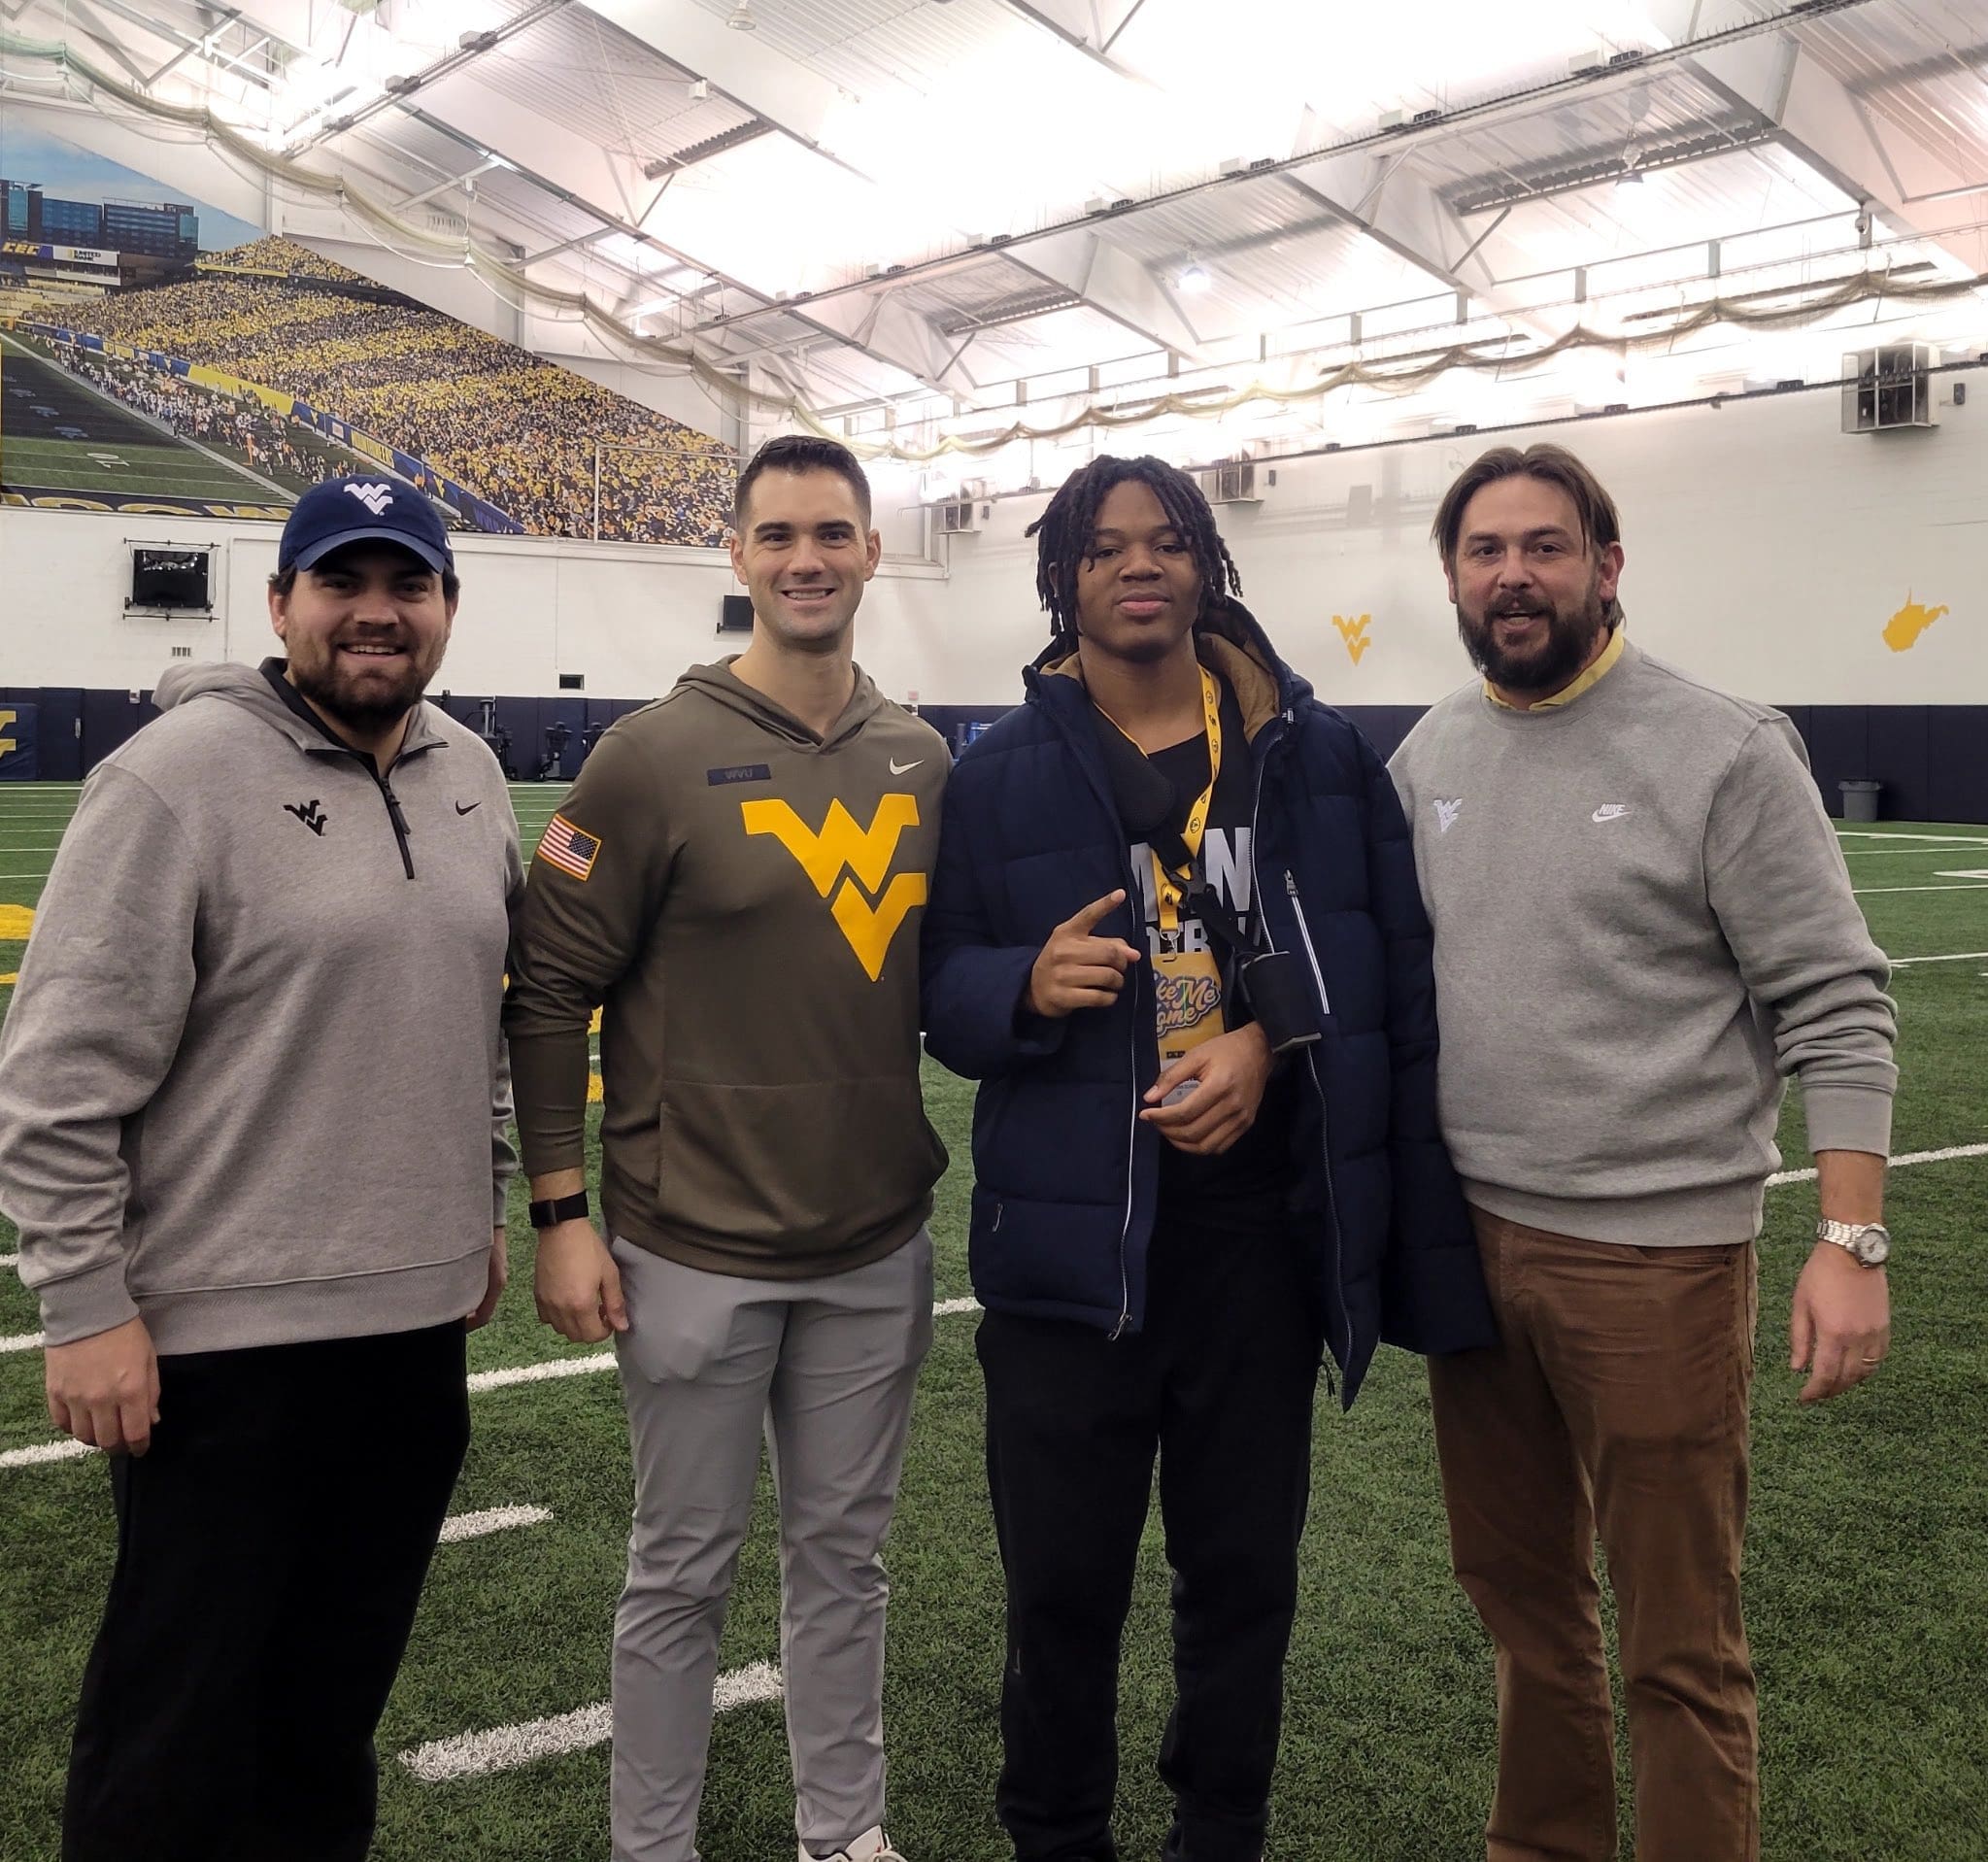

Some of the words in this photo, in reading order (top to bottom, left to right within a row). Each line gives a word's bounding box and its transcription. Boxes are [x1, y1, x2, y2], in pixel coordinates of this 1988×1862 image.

[1599, 803, 1626, 815] NIKE
[1172, 979, 1216, 1011] Me
[1157, 1007, 1197, 1033] ome
